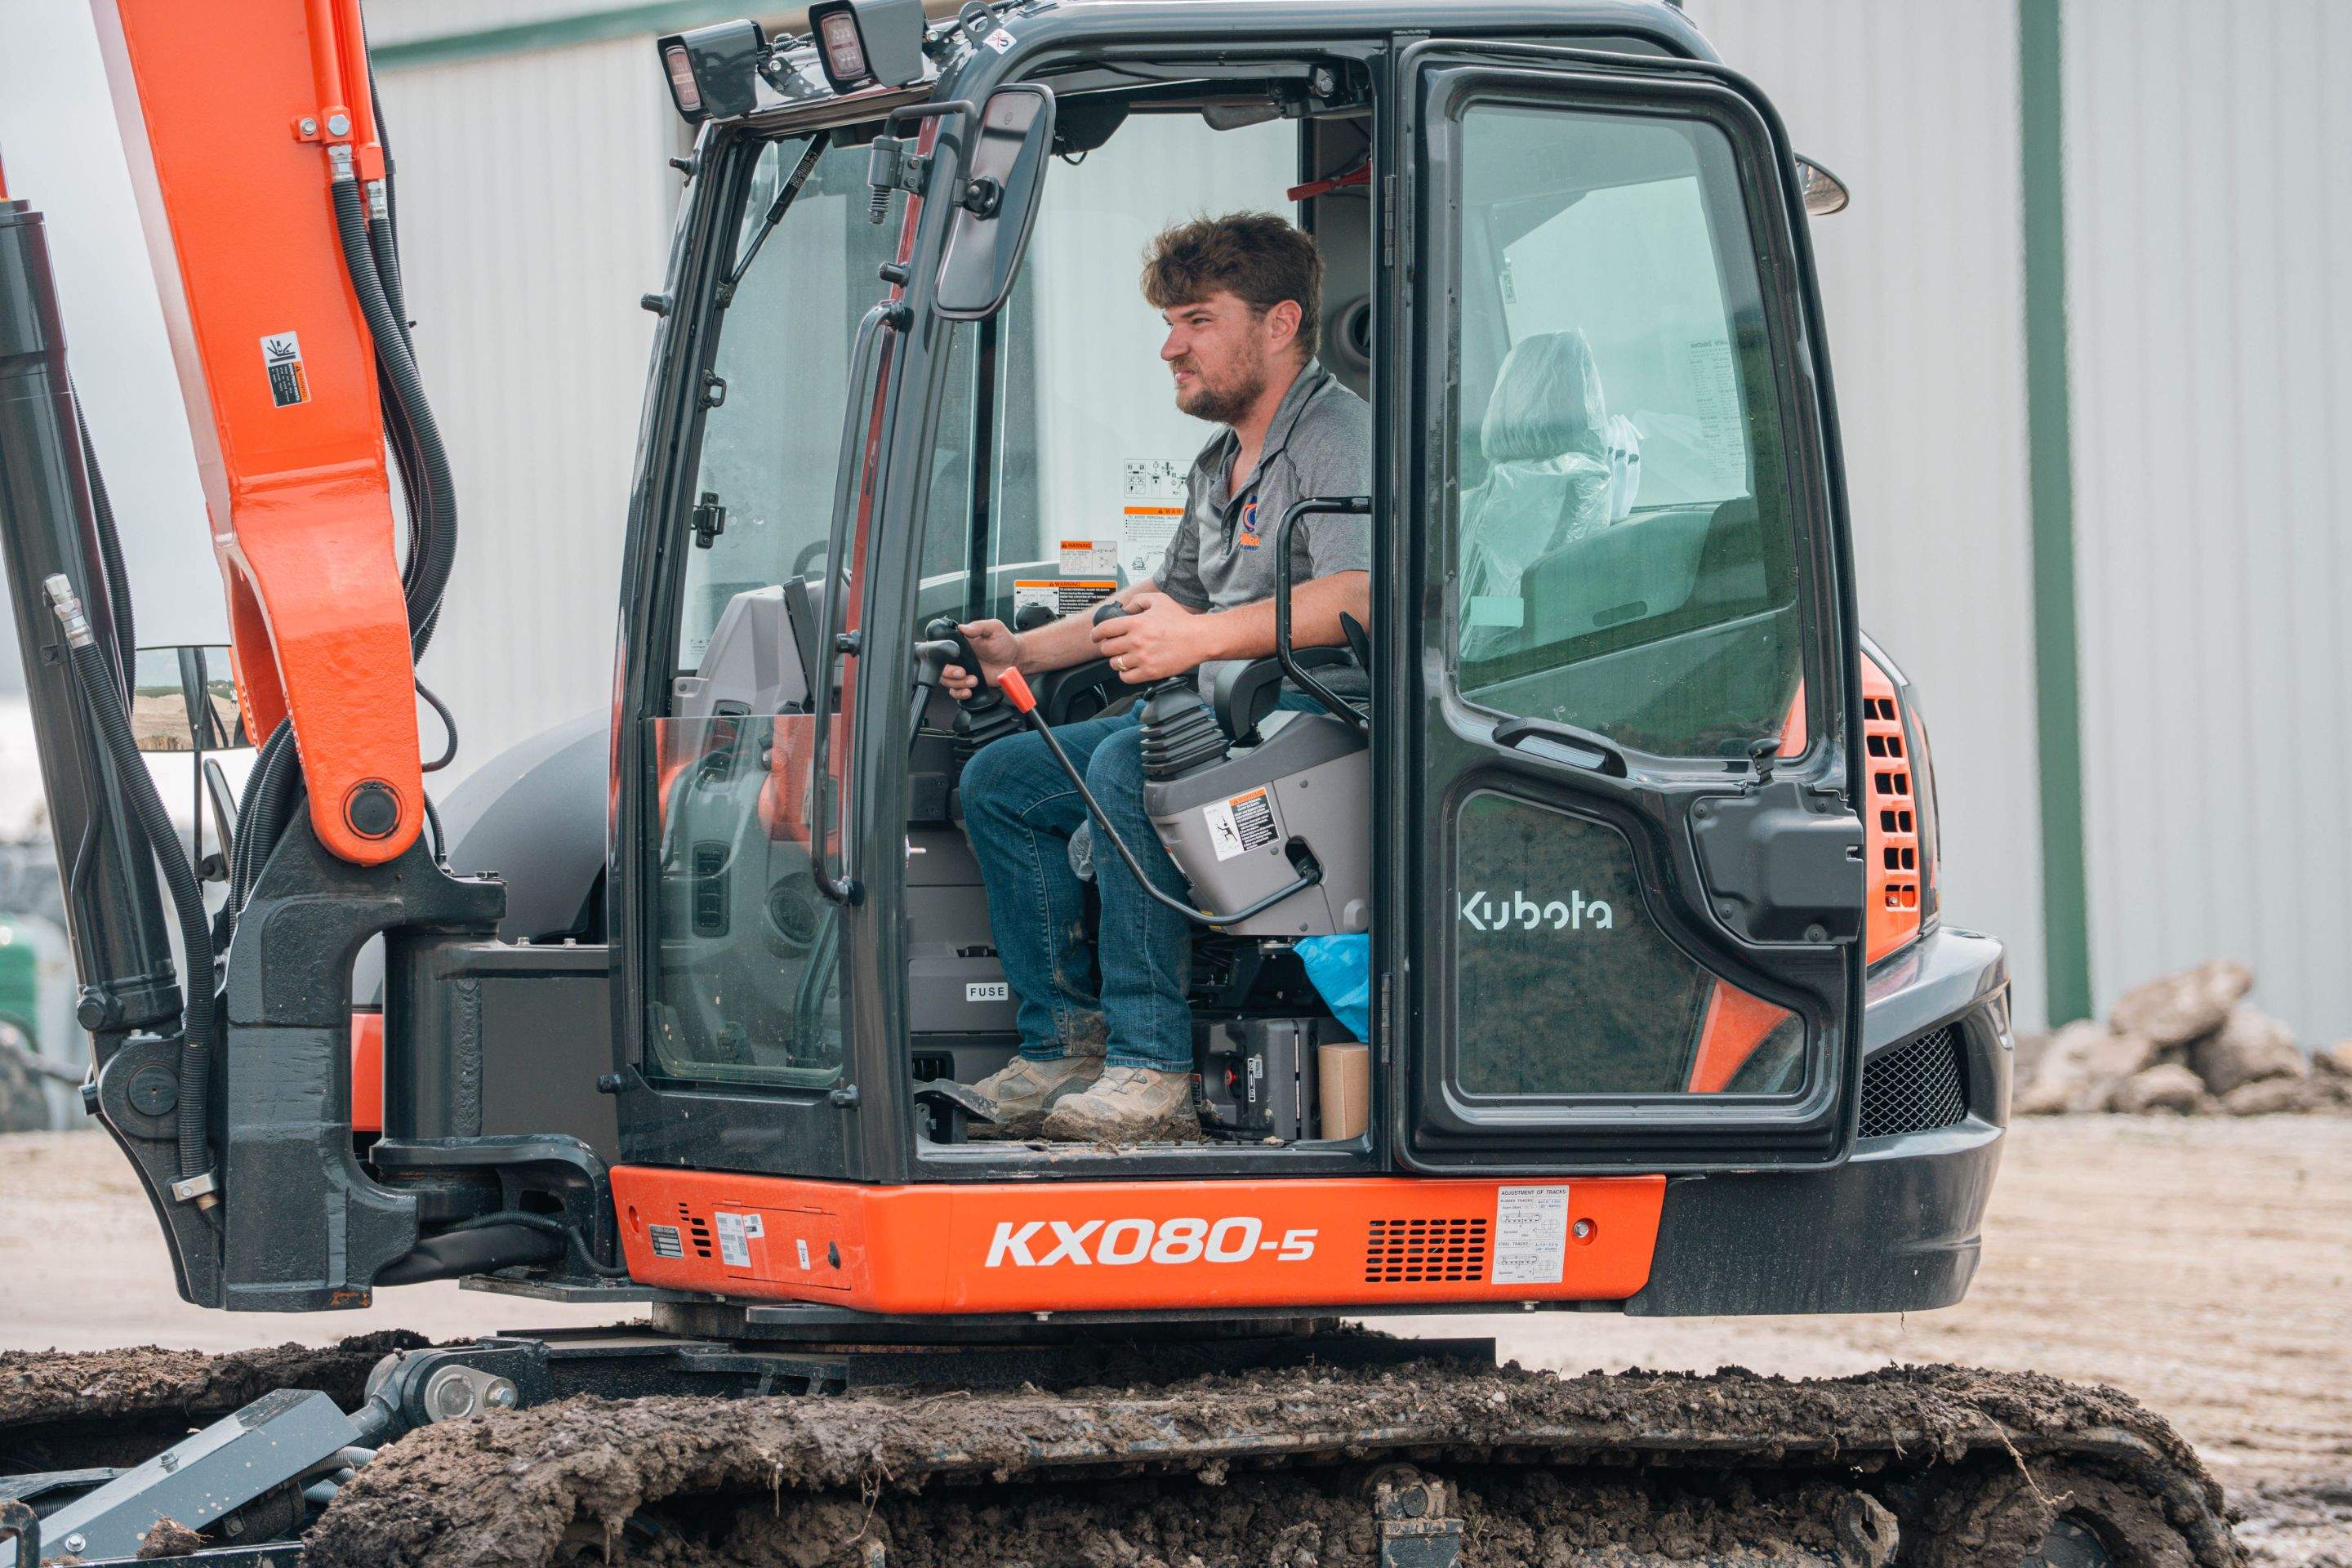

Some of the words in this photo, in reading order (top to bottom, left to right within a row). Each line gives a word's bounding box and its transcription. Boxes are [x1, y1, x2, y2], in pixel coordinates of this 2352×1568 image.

[1458, 890, 1612, 930] Kubota
[970, 987, 1004, 996] FUSE
[985, 1216, 1319, 1267] KX080-5
